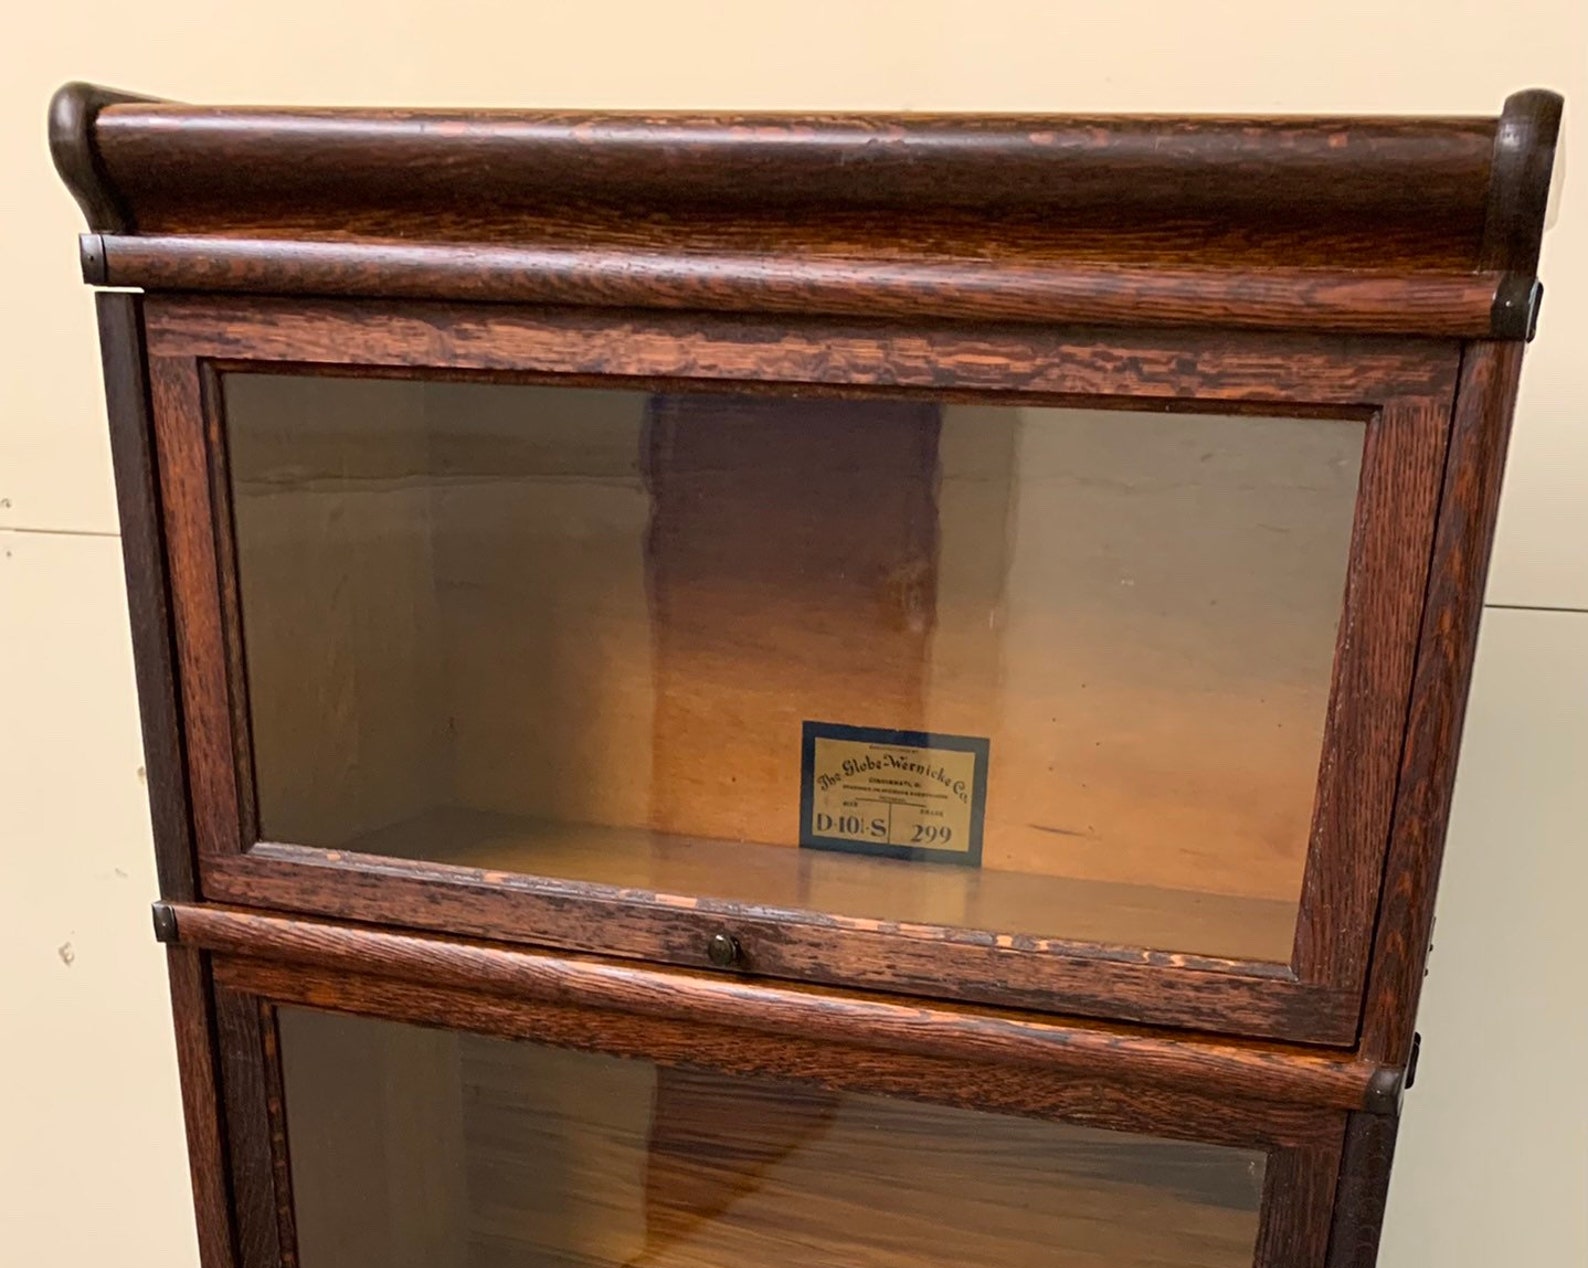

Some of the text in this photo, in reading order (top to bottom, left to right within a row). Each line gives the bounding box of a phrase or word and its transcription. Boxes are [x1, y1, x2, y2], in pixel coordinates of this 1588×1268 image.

[817, 772, 841, 791] The
[842, 753, 951, 787] Globe-Wernicke
[911, 824, 953, 844] 299
